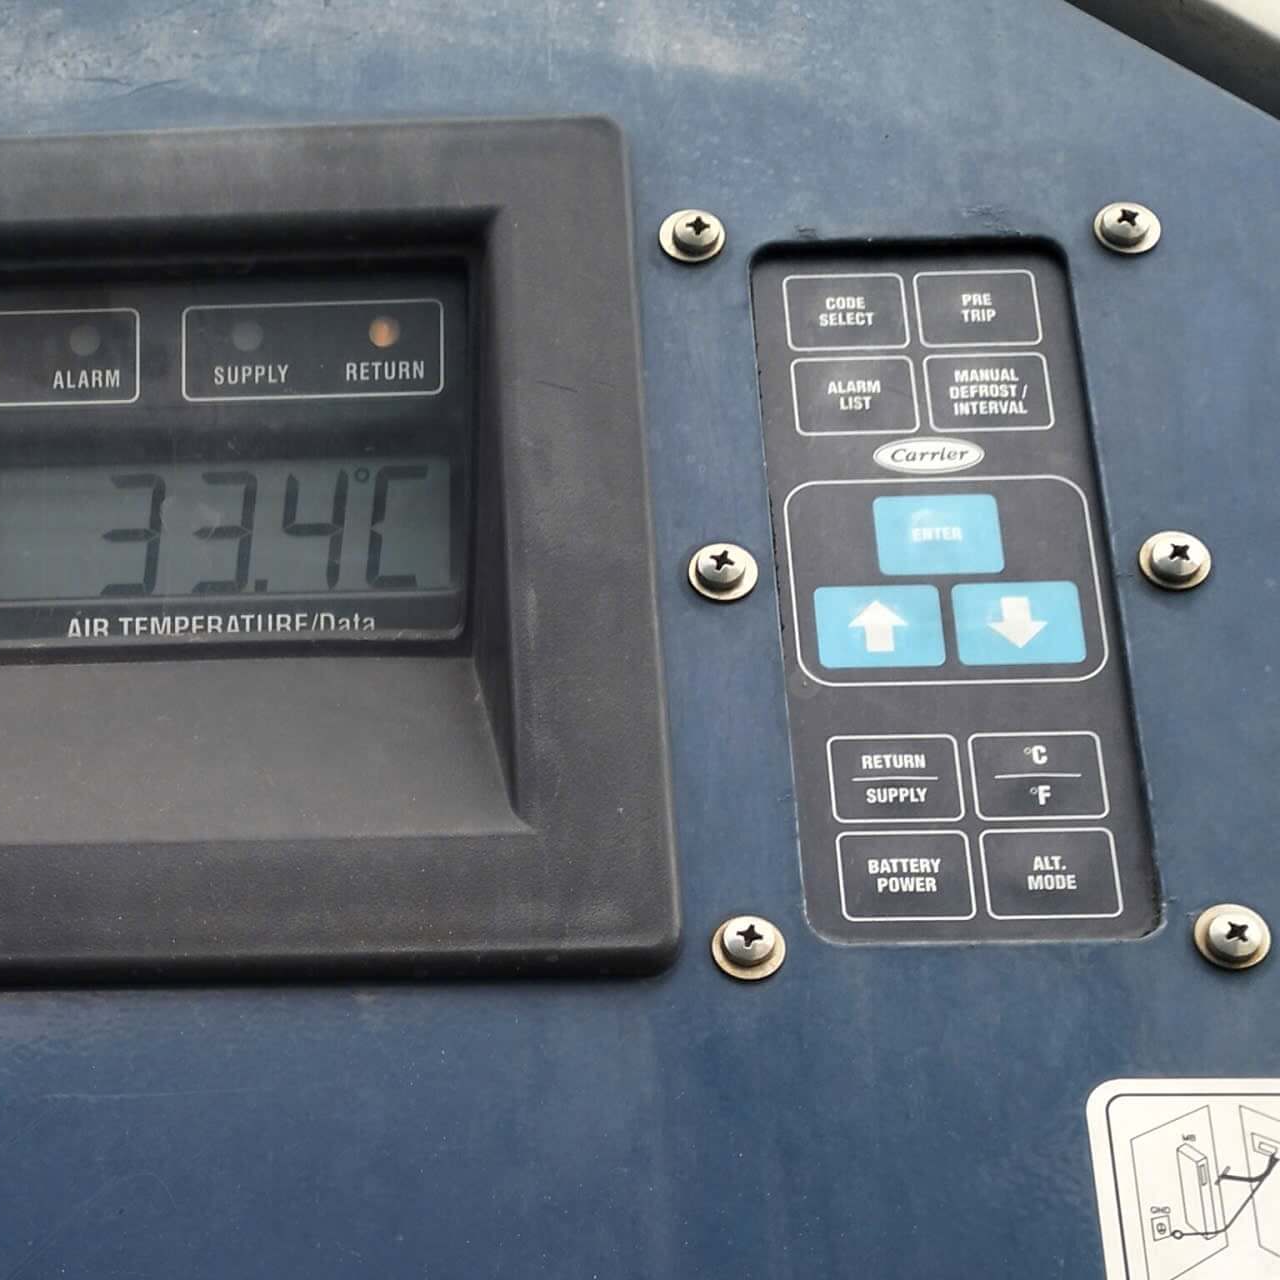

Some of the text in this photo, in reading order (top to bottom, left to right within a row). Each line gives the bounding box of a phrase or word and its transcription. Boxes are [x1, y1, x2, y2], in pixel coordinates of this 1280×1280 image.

[825, 297, 866, 311] CODE
[961, 293, 993, 307] PRE
[818, 310, 875, 328] SELECT
[961, 307, 997, 323] TRIP
[52, 368, 121, 390] ALARM
[213, 363, 289, 387] SUPPLY
[345, 359, 425, 382] RETURN
[954, 368, 1020, 384] MANUAL
[827, 380, 882, 396] ALARM
[839, 396, 872, 412] LIST
[952, 400, 1029, 417] INTERVAL
[890, 445, 969, 465] Carrier
[911, 526, 963, 543] ENTER
[67, 617, 110, 638] AIR
[861, 752, 926, 771] RETURN
[865, 786, 927, 806] SUPPLY
[867, 857, 942, 875] BATTERY
[1032, 854, 1067, 873] ALT.
[876, 874, 938, 894] POWER
[1027, 872, 1077, 891] MODE
